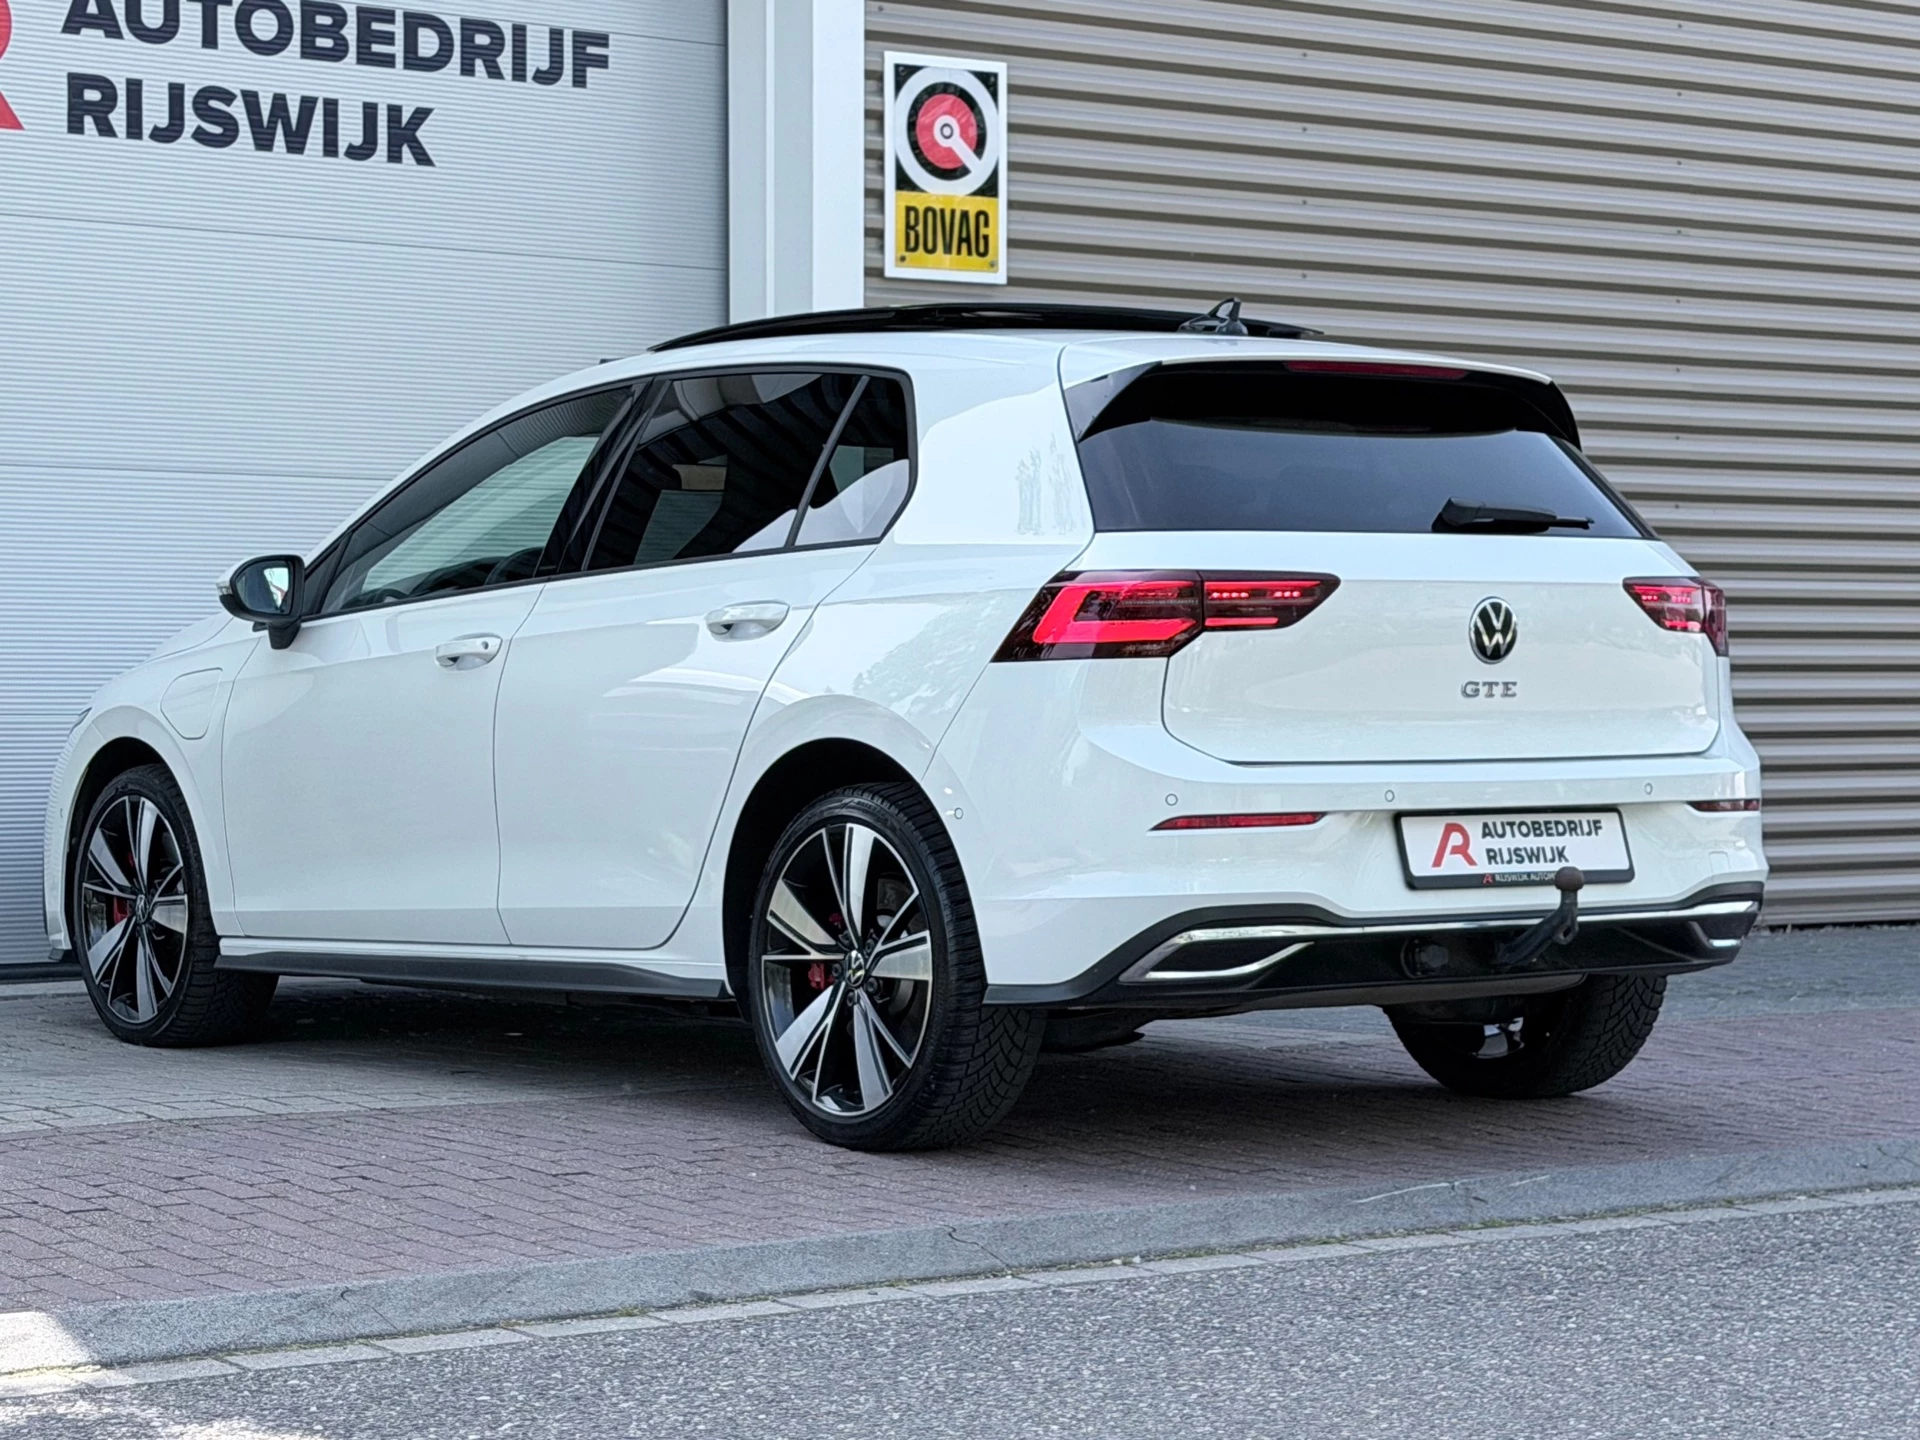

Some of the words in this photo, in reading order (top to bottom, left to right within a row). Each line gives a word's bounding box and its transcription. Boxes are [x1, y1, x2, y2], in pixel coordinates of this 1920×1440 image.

[61, 0, 610, 89] AUTOBEDRIJF
[67, 72, 436, 167] RIJSWIJK
[905, 205, 989, 258] BOVAG
[1461, 681, 1517, 698] GTE
[1481, 819, 1603, 839] AUTOBEDRIJF
[1485, 845, 1569, 866] RIJSWIJK
